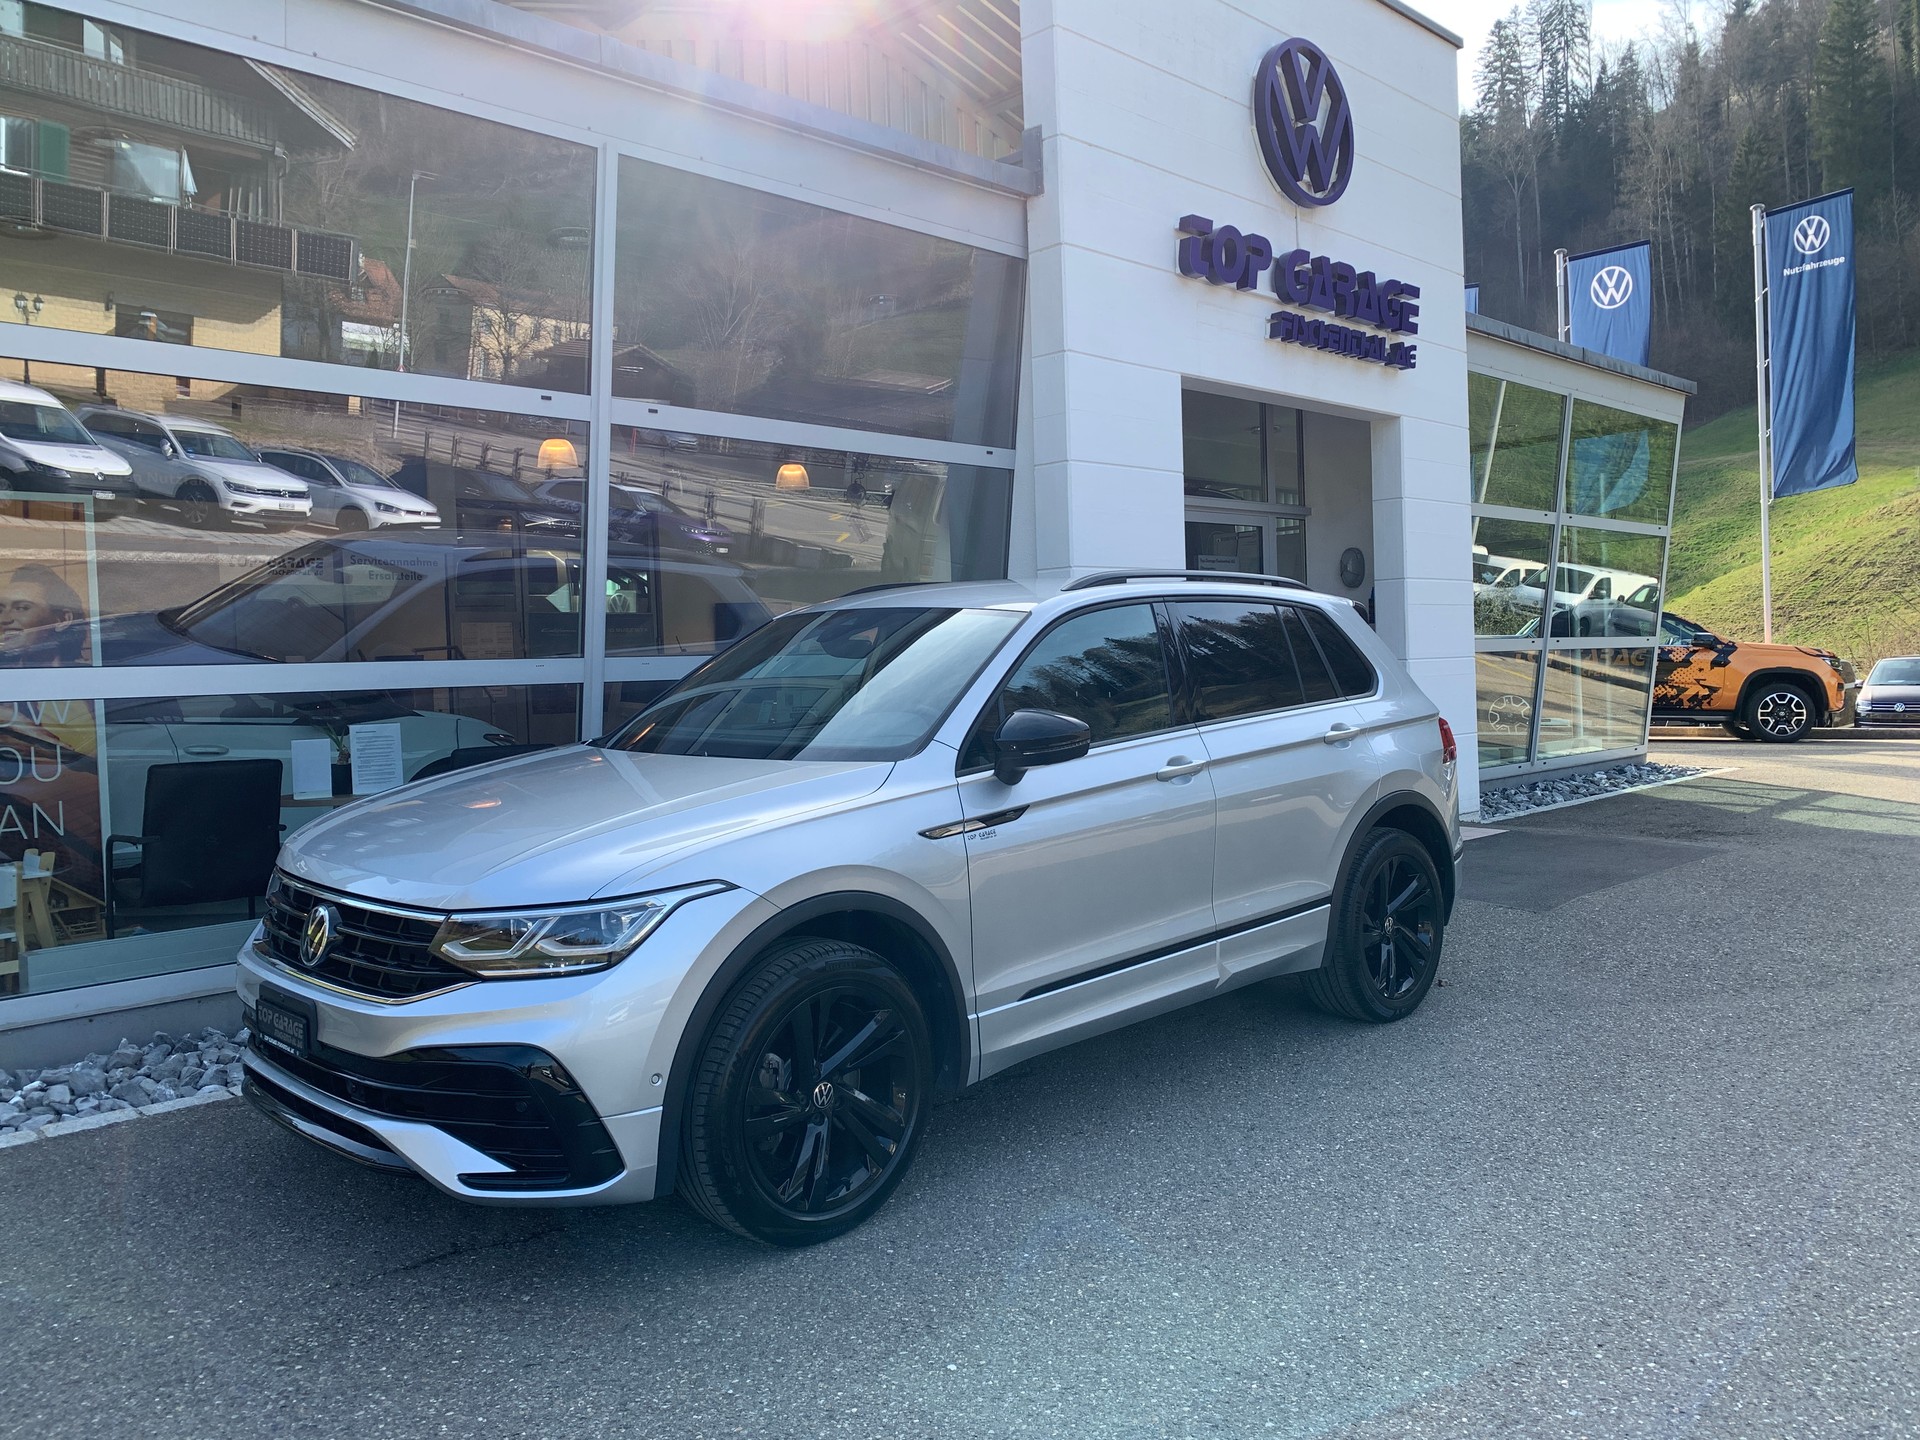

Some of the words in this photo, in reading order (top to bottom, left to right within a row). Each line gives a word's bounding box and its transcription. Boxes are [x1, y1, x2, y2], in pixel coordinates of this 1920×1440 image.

[1178, 214, 1273, 292] TOP
[1274, 248, 1421, 336] GARAGE
[1783, 256, 1845, 277] Nutzfahrzeuge
[350, 554, 439, 567] Serviceannahme
[368, 570, 423, 581] Ersatzteile
[273, 1013, 304, 1039] GARAGE
